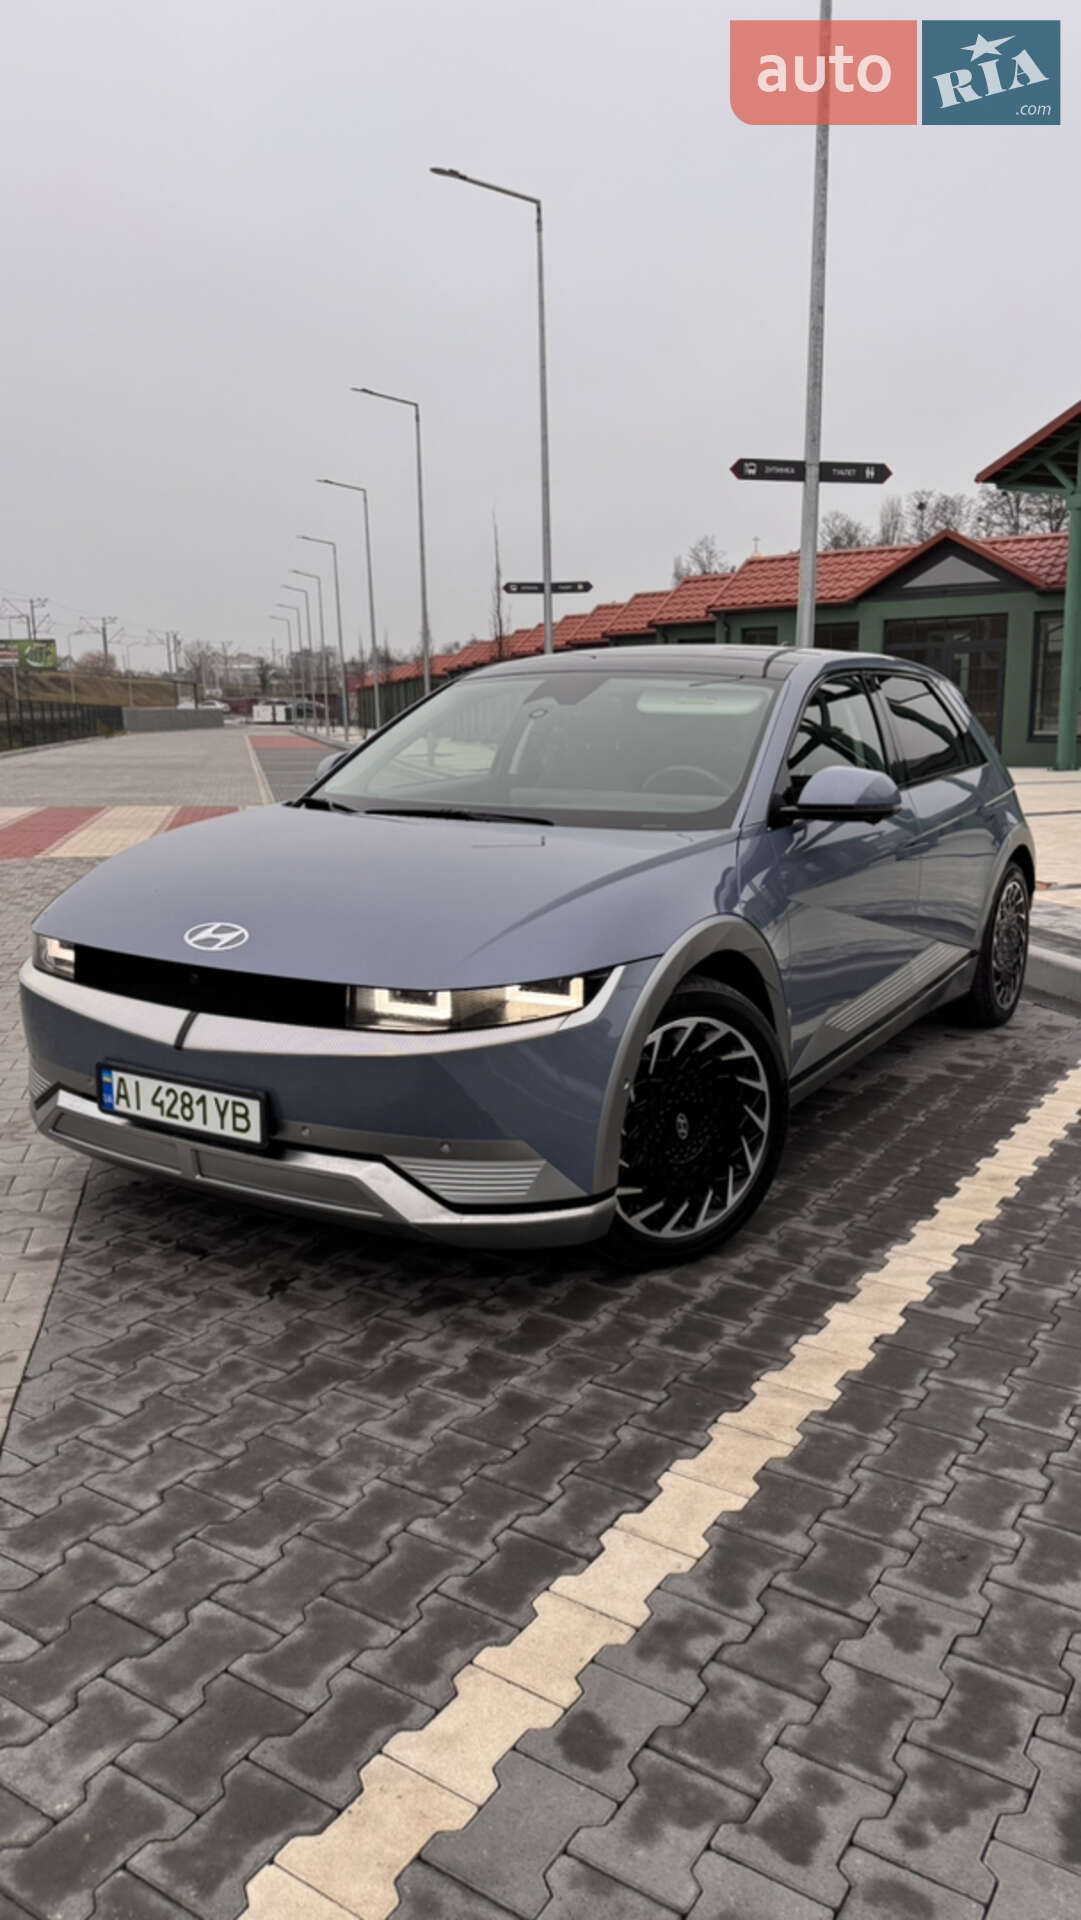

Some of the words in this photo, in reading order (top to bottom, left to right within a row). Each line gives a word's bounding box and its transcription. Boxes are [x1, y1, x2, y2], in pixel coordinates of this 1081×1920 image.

[115, 1077, 141, 1111] AI
[151, 1085, 208, 1126] 4281
[214, 1096, 251, 1134] YB
